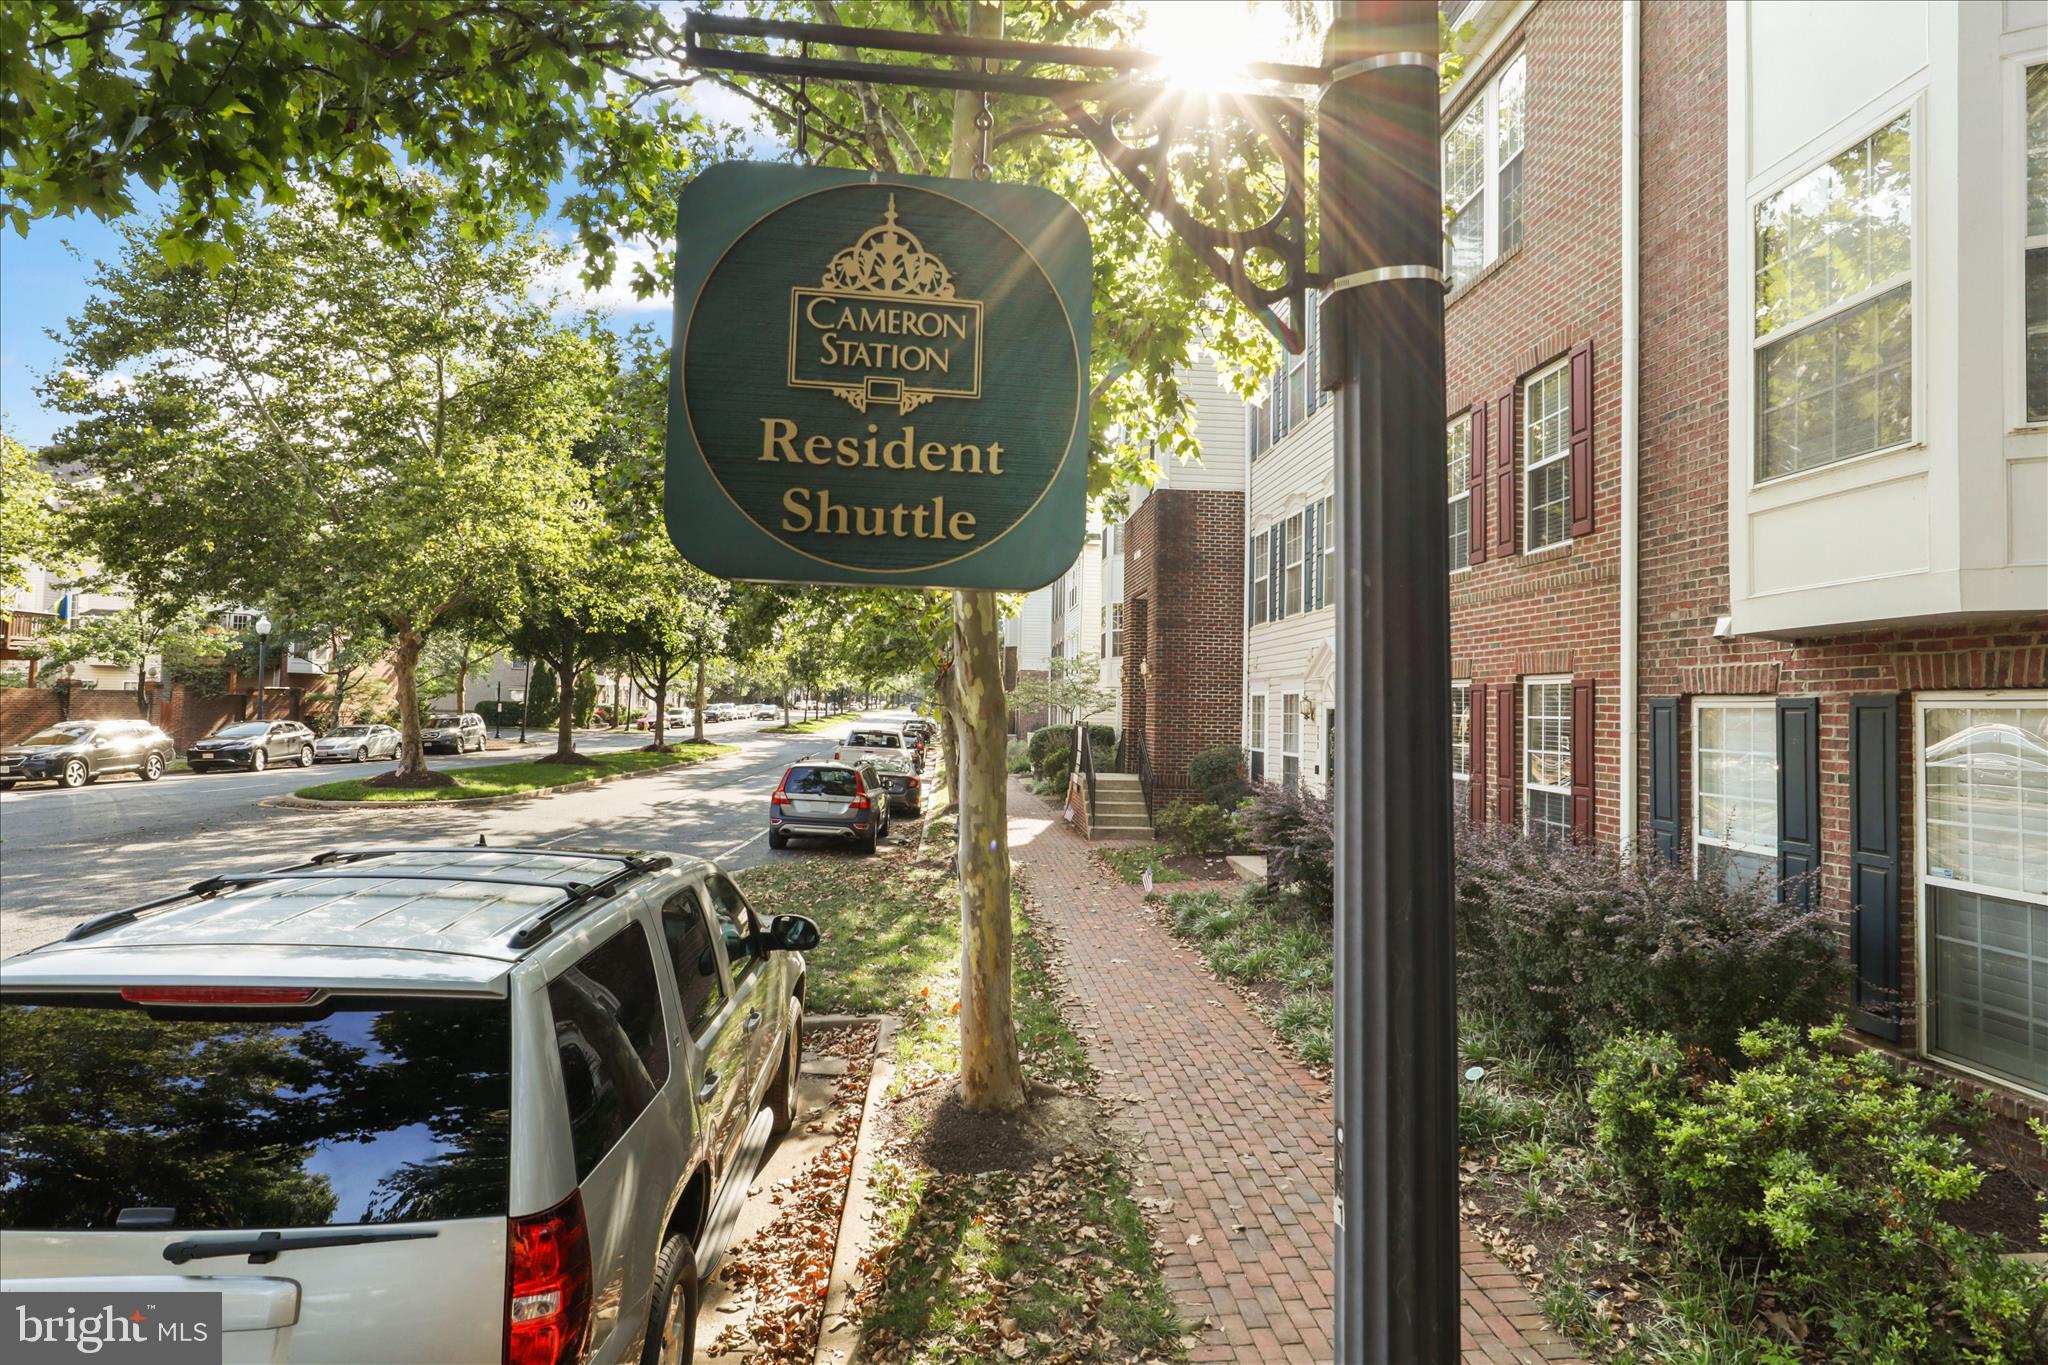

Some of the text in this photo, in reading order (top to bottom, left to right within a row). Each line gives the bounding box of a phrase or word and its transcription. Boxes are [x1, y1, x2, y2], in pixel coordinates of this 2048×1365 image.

[806, 297, 966, 339] CAMERON
[820, 333, 949, 373] STATION
[757, 418, 1005, 475] Resident
[782, 487, 977, 542] Shuttle
